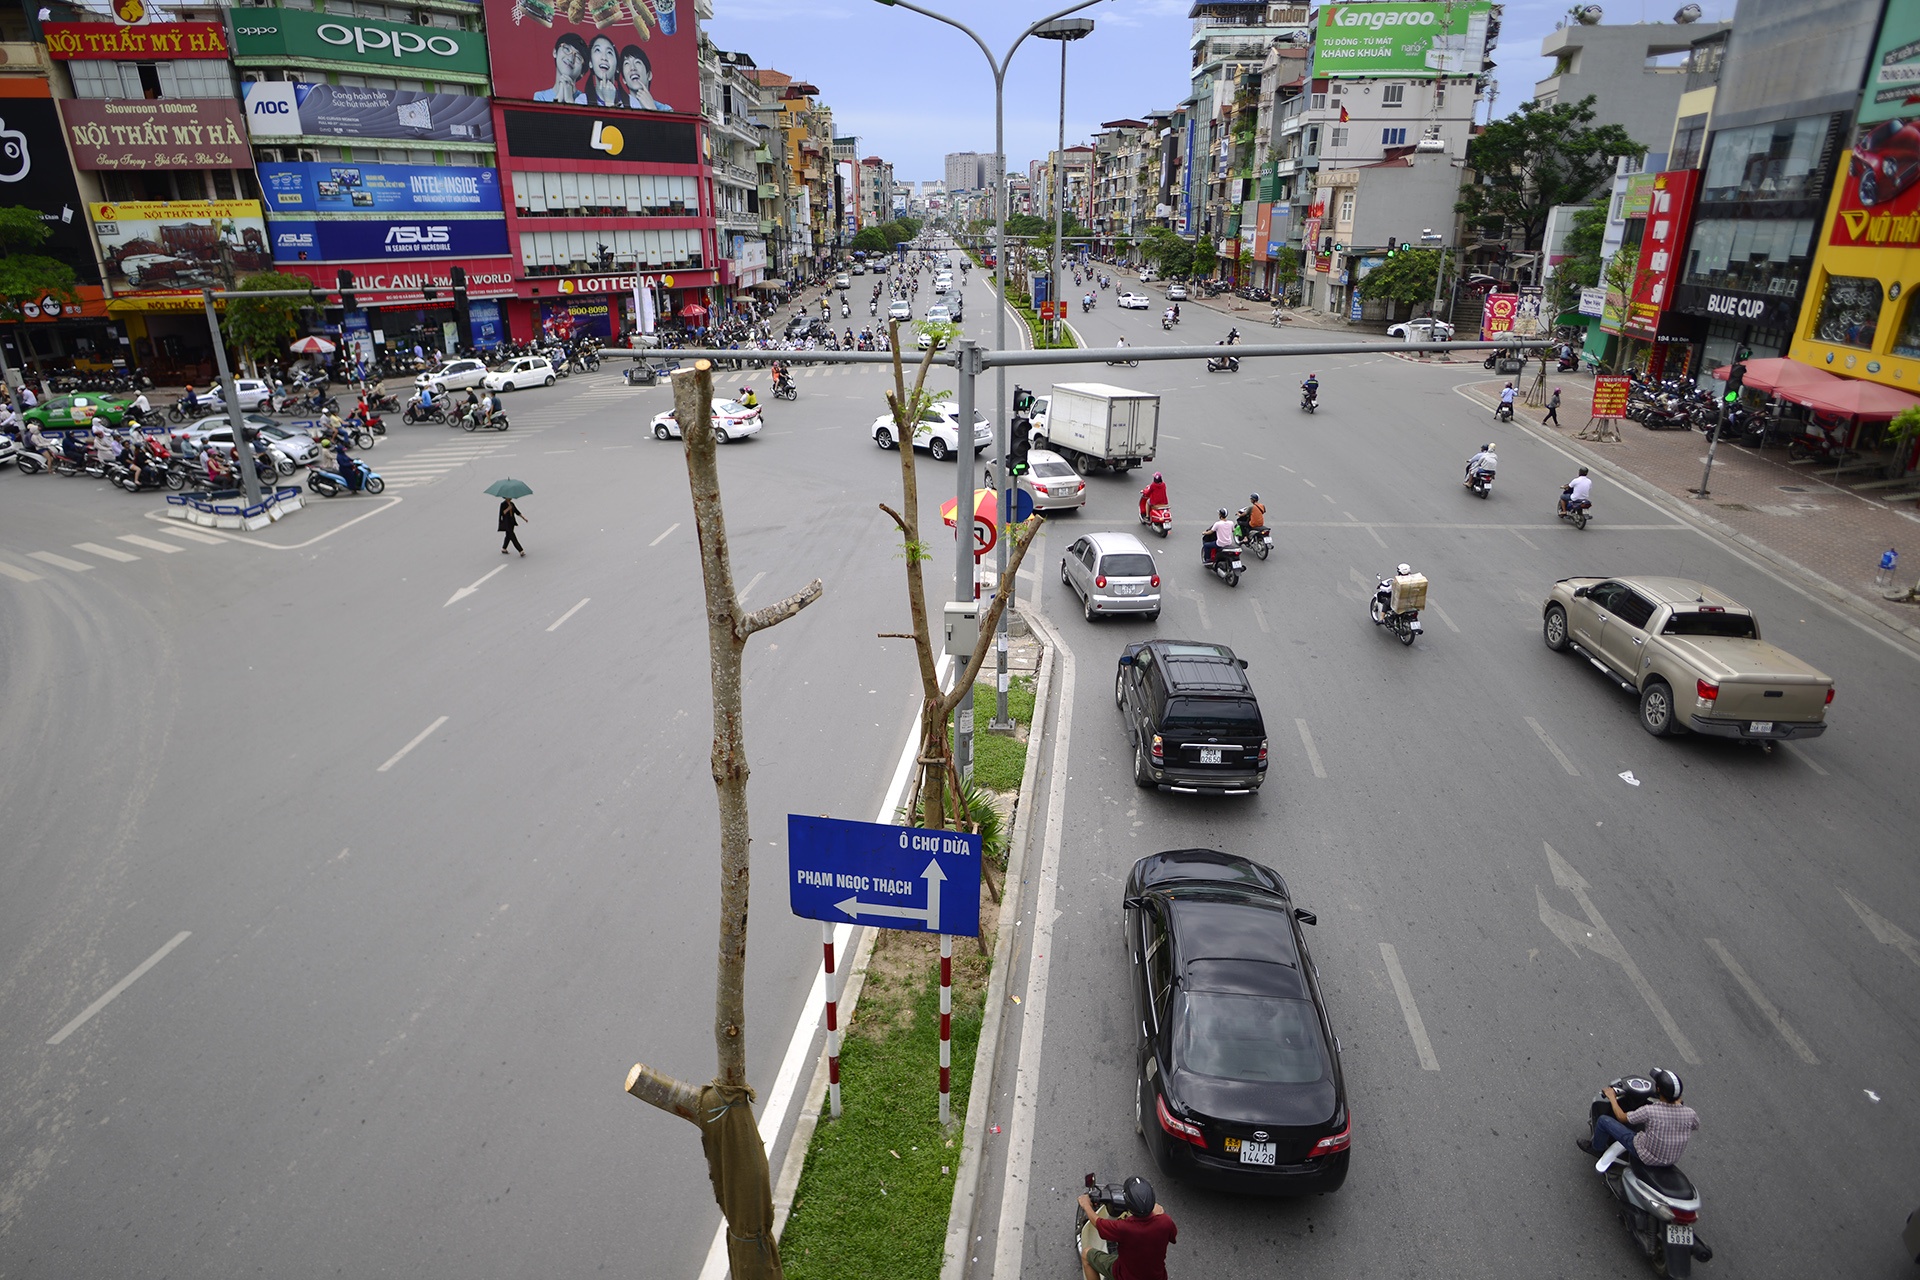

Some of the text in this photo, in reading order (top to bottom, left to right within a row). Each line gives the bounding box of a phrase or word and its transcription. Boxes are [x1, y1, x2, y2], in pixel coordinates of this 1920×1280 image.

[44, 25, 226, 57] NỘI THẤT MỸ HÀ
[105, 104, 198, 114] Showroom 1000m2
[72, 116, 242, 150] NỘI THẤT MỸ HÀ
[278, 234, 312, 242] ASUS
[385, 226, 450, 243] ASUS
[472, 274, 511, 285] WORLD
[578, 276, 656, 292] LOTTERIA
[1707, 294, 1764, 318] BLUE CUP
[900, 831, 970, 856] Ô CHỢ DỪA
[798, 870, 912, 896] PHẠM NGỌC THẠCH
[1243, 1152, 1274, 1164] 144.28
